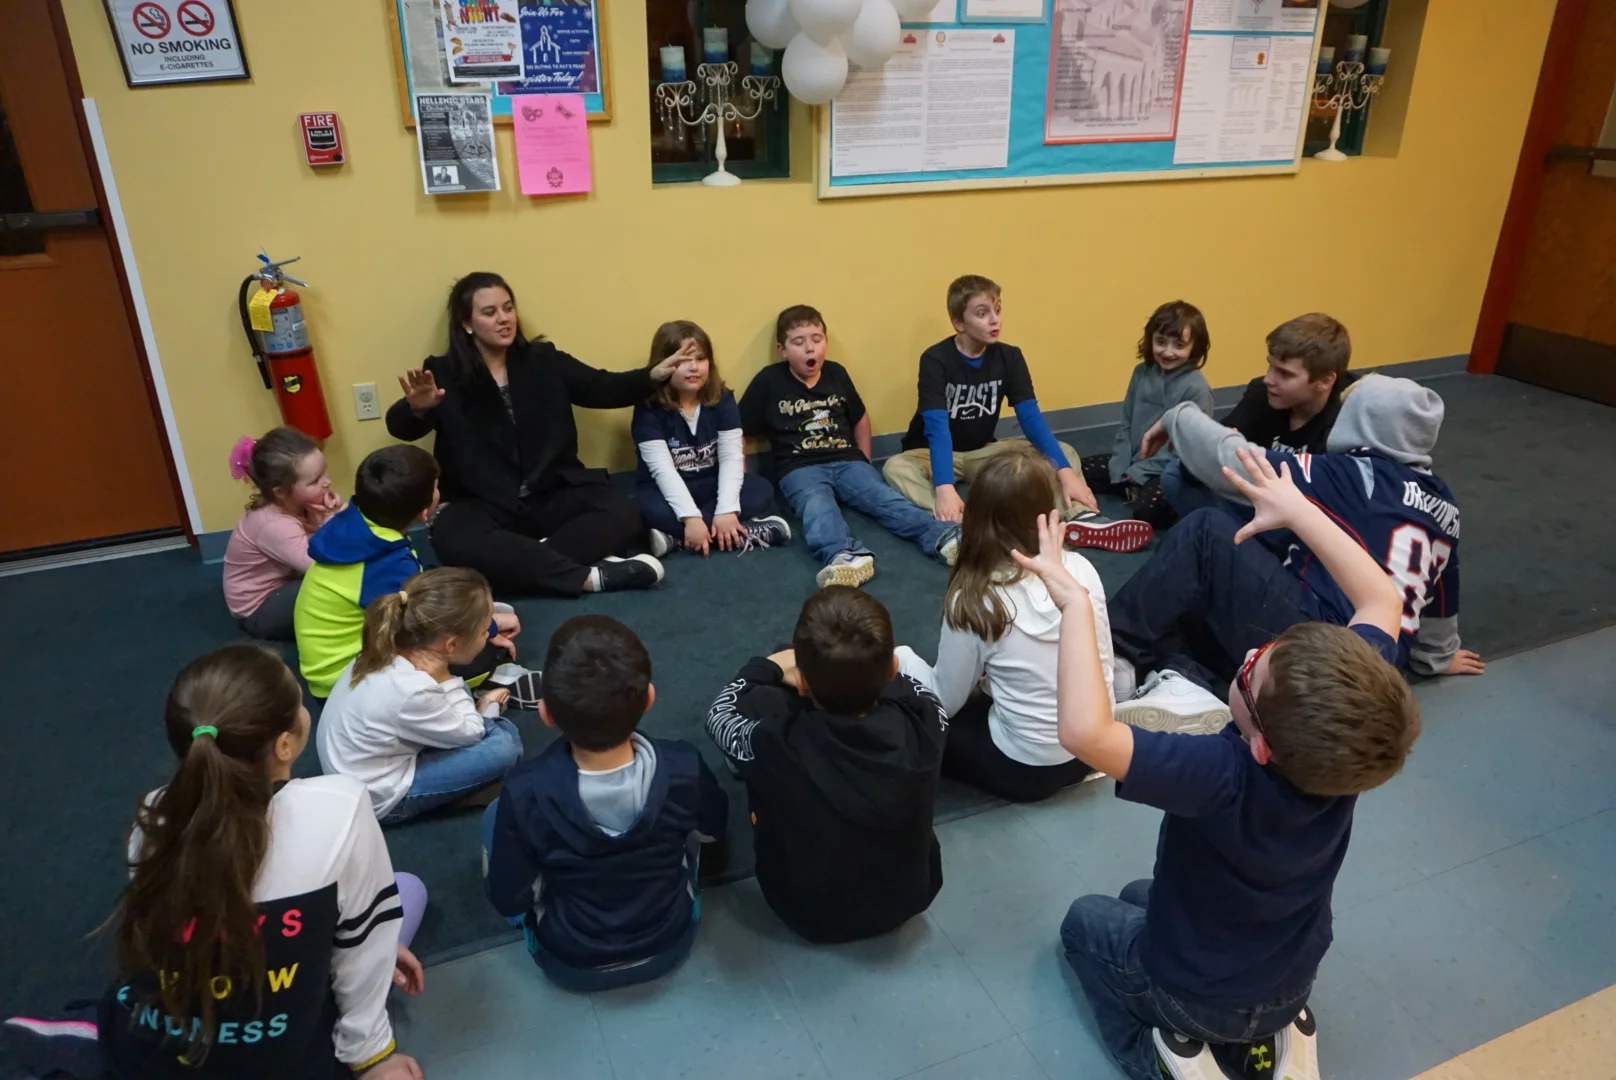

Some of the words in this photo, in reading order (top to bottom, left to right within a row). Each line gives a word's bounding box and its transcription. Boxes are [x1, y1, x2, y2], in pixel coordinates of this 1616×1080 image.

[520, 6, 537, 18] Join
[538, 7, 549, 17] Us
[550, 8, 564, 16] For
[131, 42, 154, 55] NO
[158, 38, 231, 53] SMOKING
[164, 54, 205, 62] INCLUDING
[160, 61, 214, 70] E-CIGARETTES
[552, 70, 584, 86] Today!
[420, 97, 458, 105] HELLENIC
[462, 96, 485, 104] STARS
[304, 115, 334, 126] FIRE
